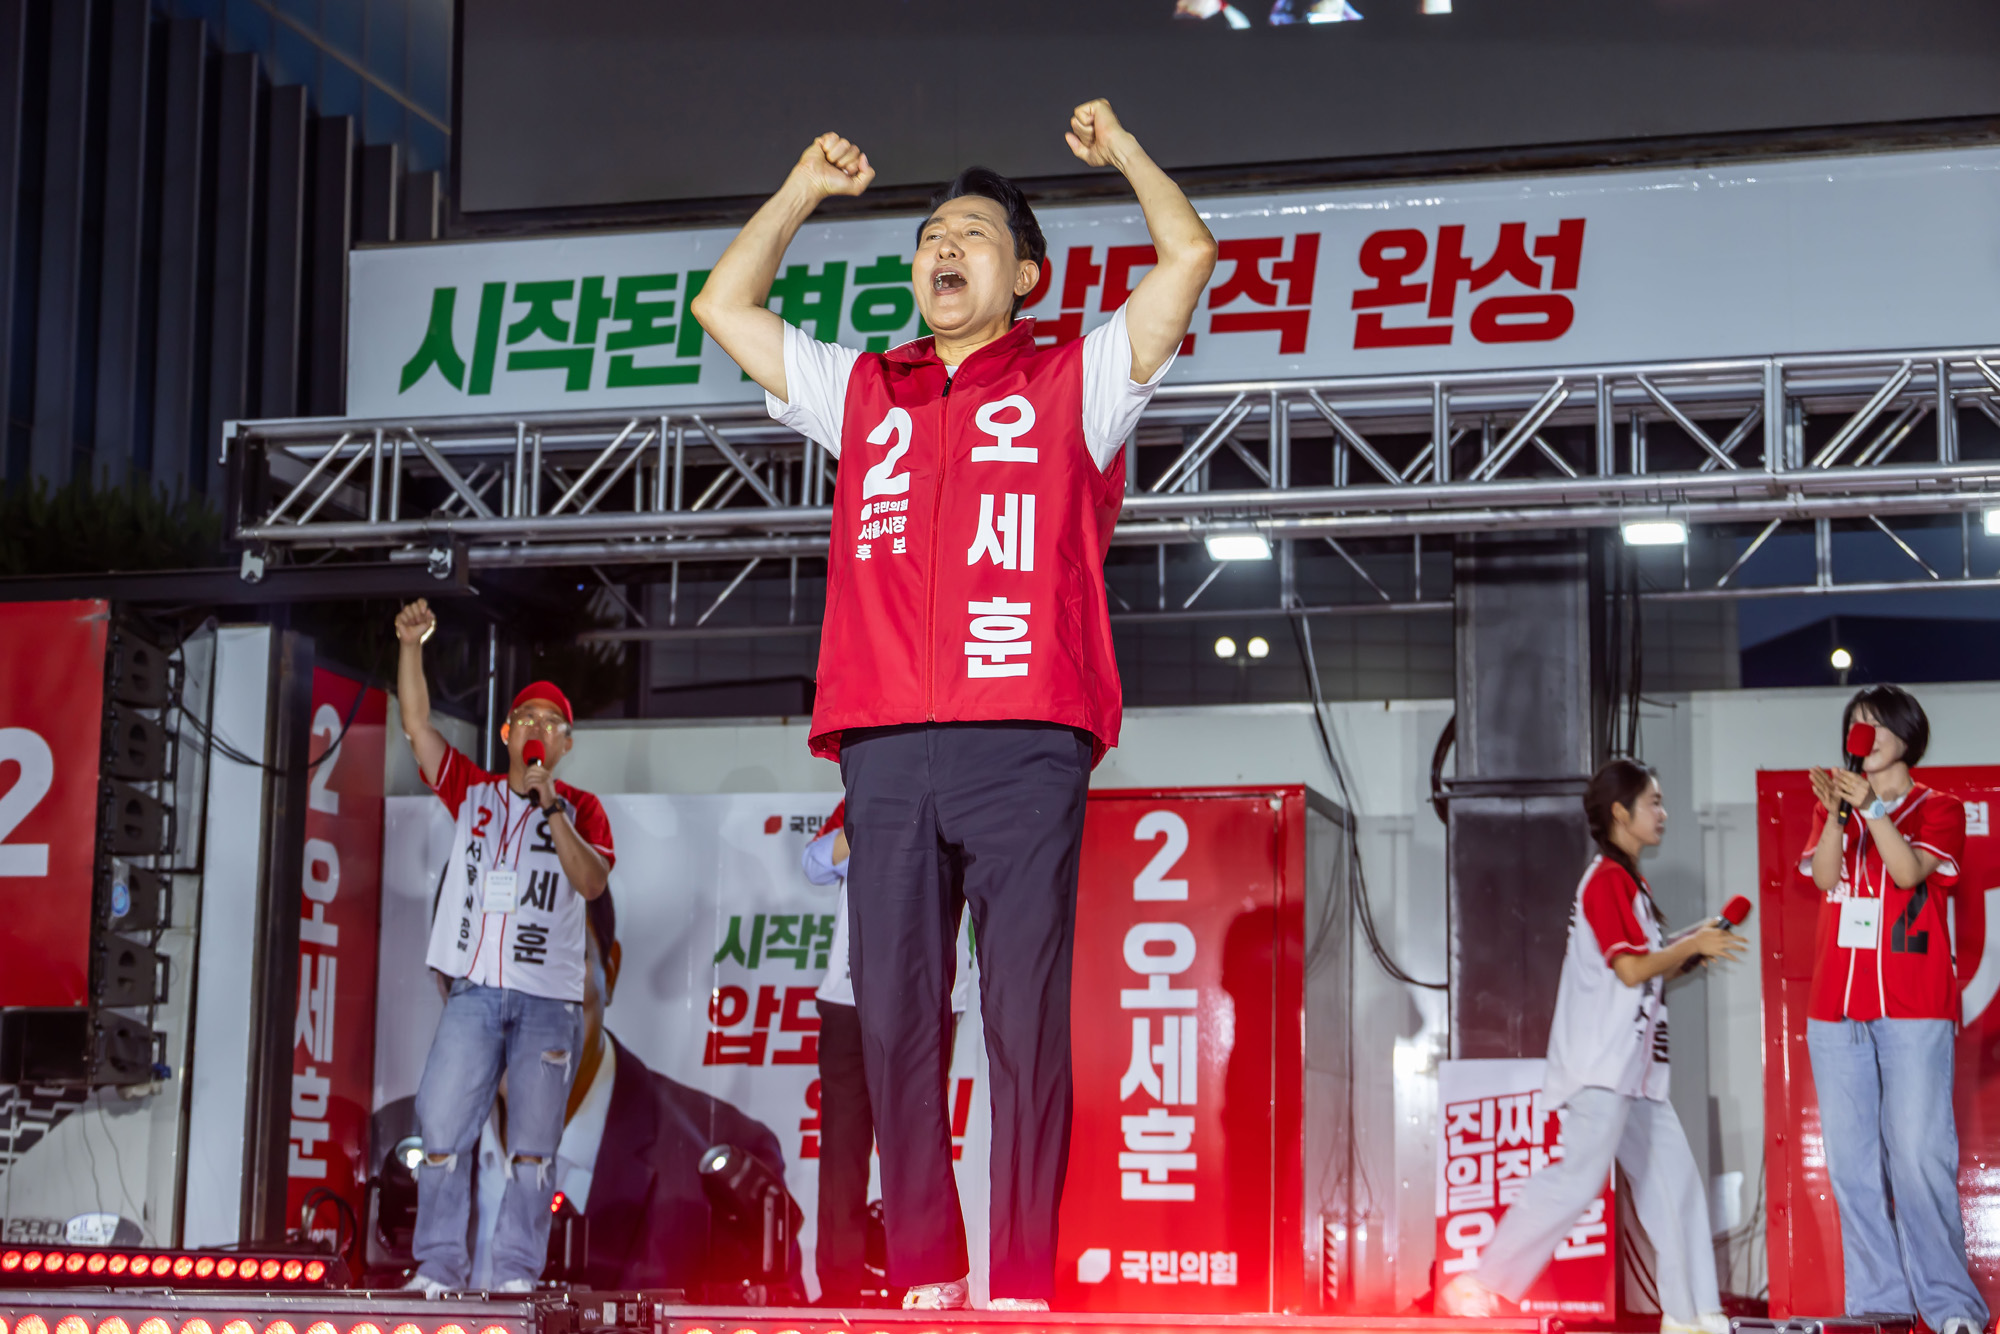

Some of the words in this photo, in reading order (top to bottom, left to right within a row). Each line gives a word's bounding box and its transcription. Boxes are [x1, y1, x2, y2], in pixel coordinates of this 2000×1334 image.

[399, 269, 712, 396] 시작된
[1351, 217, 1586, 350] 완성
[862, 406, 913, 500] 2
[858, 515, 907, 541] 서울시장
[873, 498, 909, 514] 국민의힘
[963, 394, 1039, 679] 오세훈
[308, 702, 342, 816] 2
[471, 805, 493, 838] 2
[1132, 809, 1190, 902] 2
[512, 818, 560, 966] 오세훈
[287, 837, 341, 1180] 오세훈
[702, 985, 823, 1067] 압도
[1119, 921, 1199, 1201] 오세훈
[1119, 1250, 1239, 1287] 국민의힘
